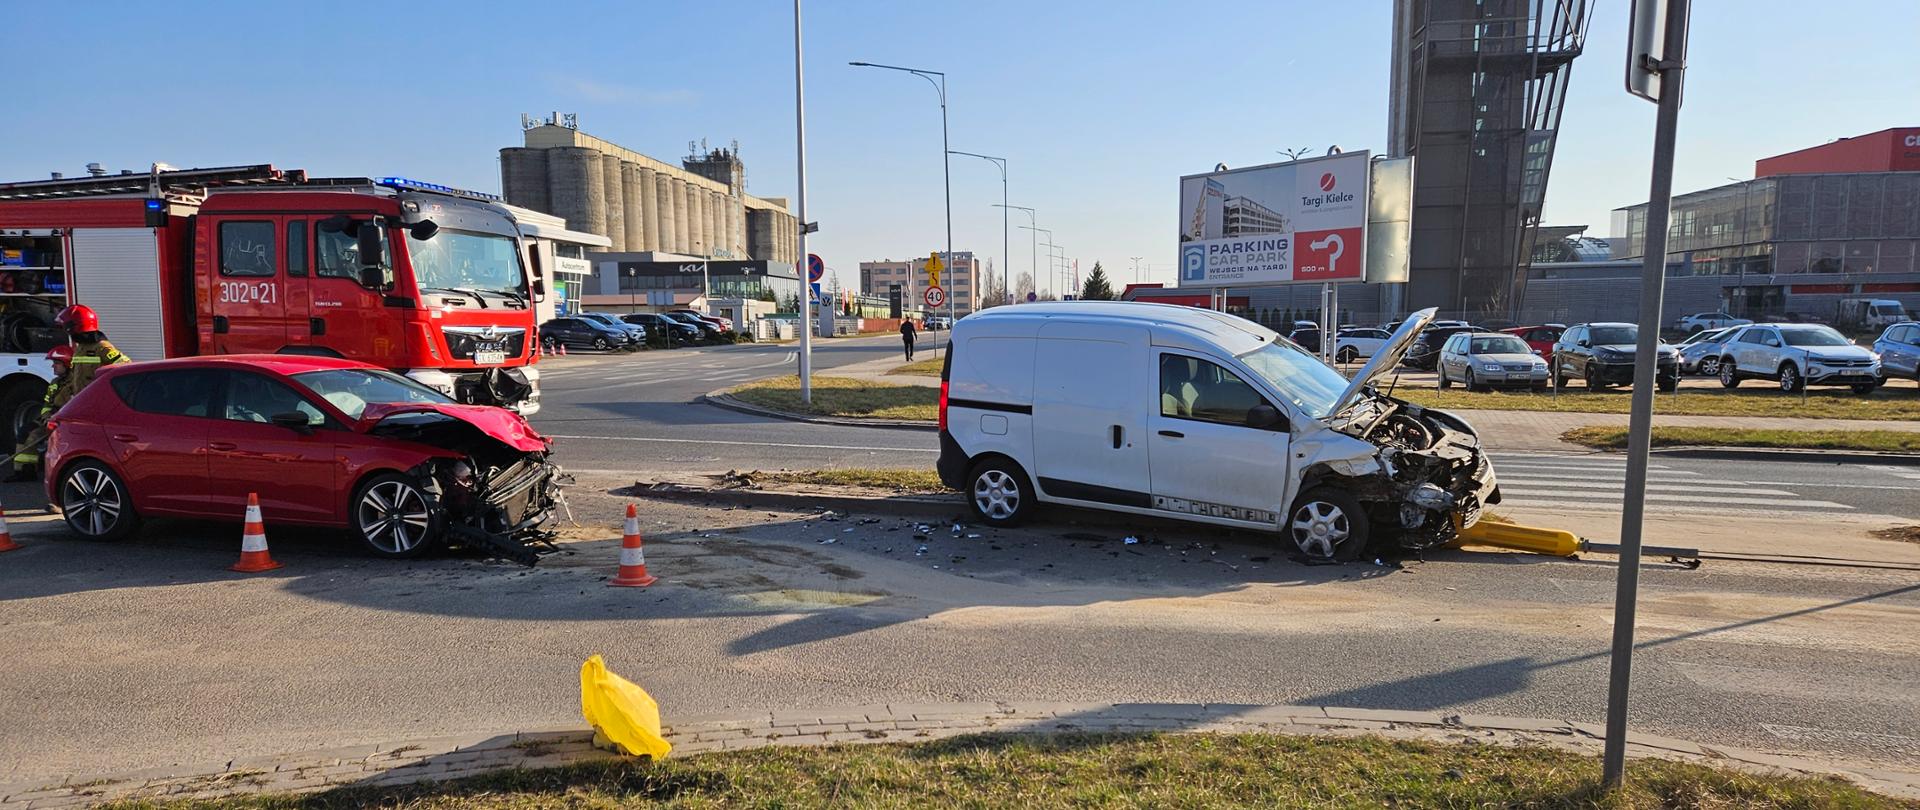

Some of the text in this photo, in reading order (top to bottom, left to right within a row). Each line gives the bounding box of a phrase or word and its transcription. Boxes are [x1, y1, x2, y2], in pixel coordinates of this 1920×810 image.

[1302, 192, 1354, 208] Targi Kielce
[1210, 239, 1288, 255] PARKING
[1209, 251, 1288, 266] CAR PARK
[220, 282, 250, 303] 302
[259, 282, 277, 303] 21
[928, 292, 942, 301] 40
